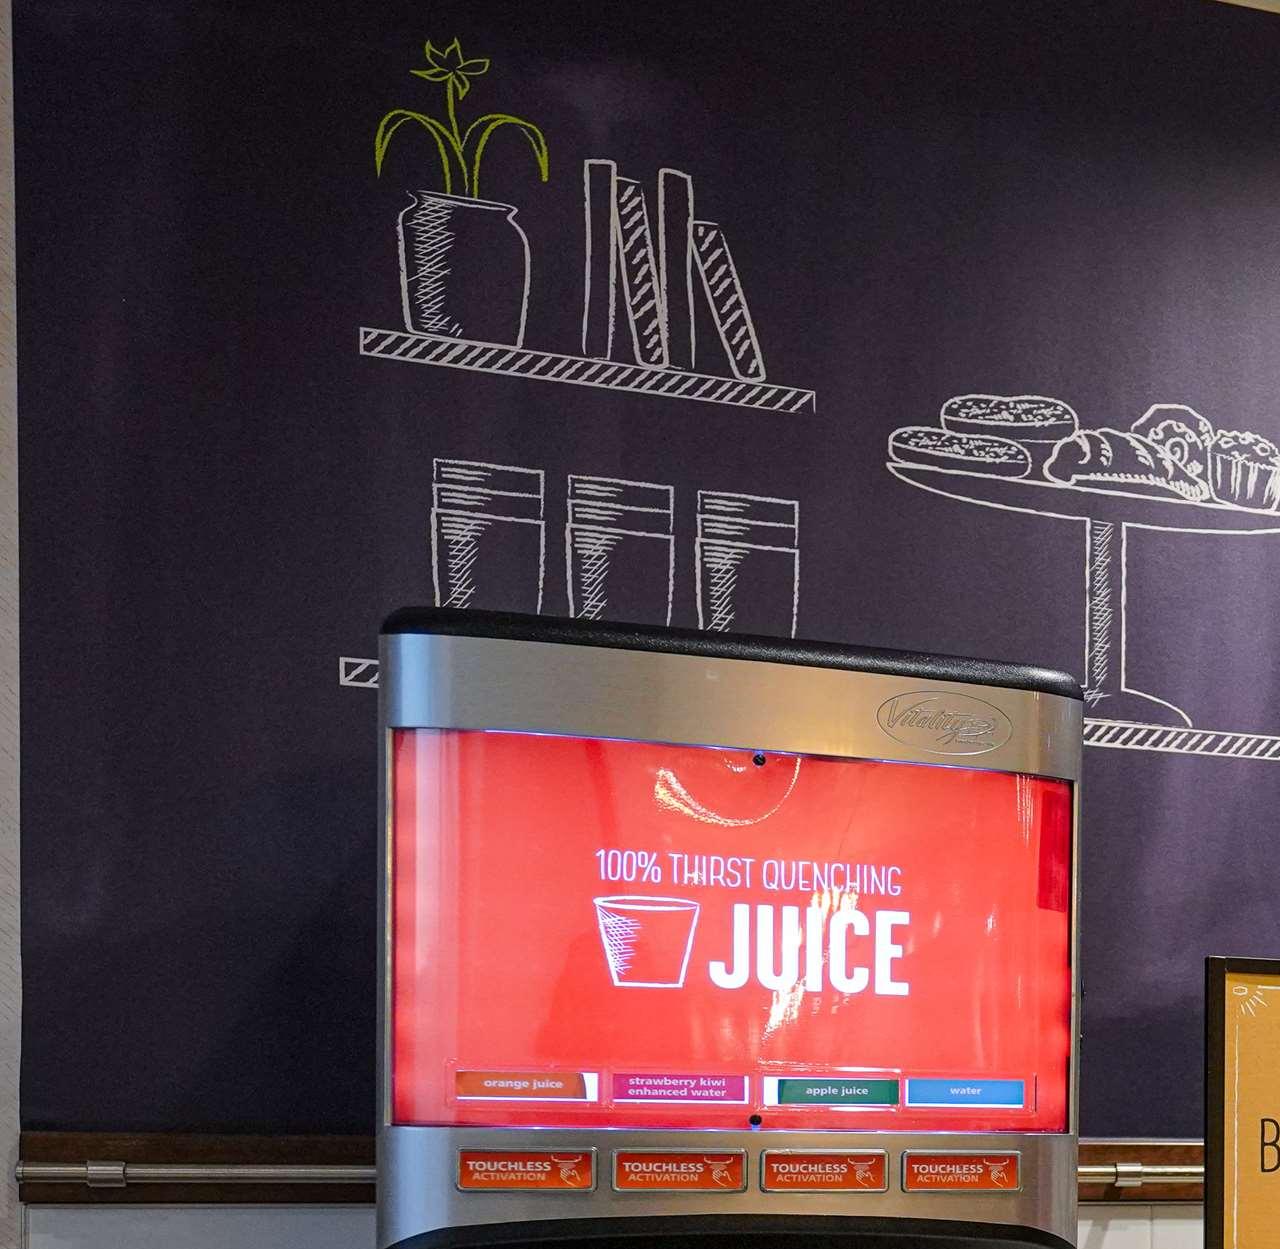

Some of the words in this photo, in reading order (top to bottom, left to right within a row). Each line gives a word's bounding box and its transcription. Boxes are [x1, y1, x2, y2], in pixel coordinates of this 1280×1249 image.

[595, 848, 662, 884] 100%
[668, 852, 755, 889] THIRST
[762, 858, 902, 897] QUENCHING
[708, 902, 911, 997] JUICE
[483, 1079, 530, 1090] orange
[532, 1077, 564, 1090] juice
[628, 1076, 698, 1088] strawberry
[699, 1077, 726, 1087] kiwi
[627, 1087, 689, 1097] enhanced
[690, 1088, 727, 1097] water
[805, 1085, 839, 1097] apple
[841, 1085, 869, 1097] juice
[950, 1086, 982, 1096] water
[466, 1160, 552, 1173] TOUCHLESS
[622, 1161, 705, 1173] TOUCHLESS
[771, 1163, 848, 1174] TOUCHLESS
[911, 1164, 984, 1174] TOUCHLESS
[472, 1172, 547, 1182] ACTIVATION
[627, 1173, 699, 1183] ACTIVATION
[776, 1174, 844, 1183] ACTIVATION
[916, 1174, 980, 1184] ACTIVATION
